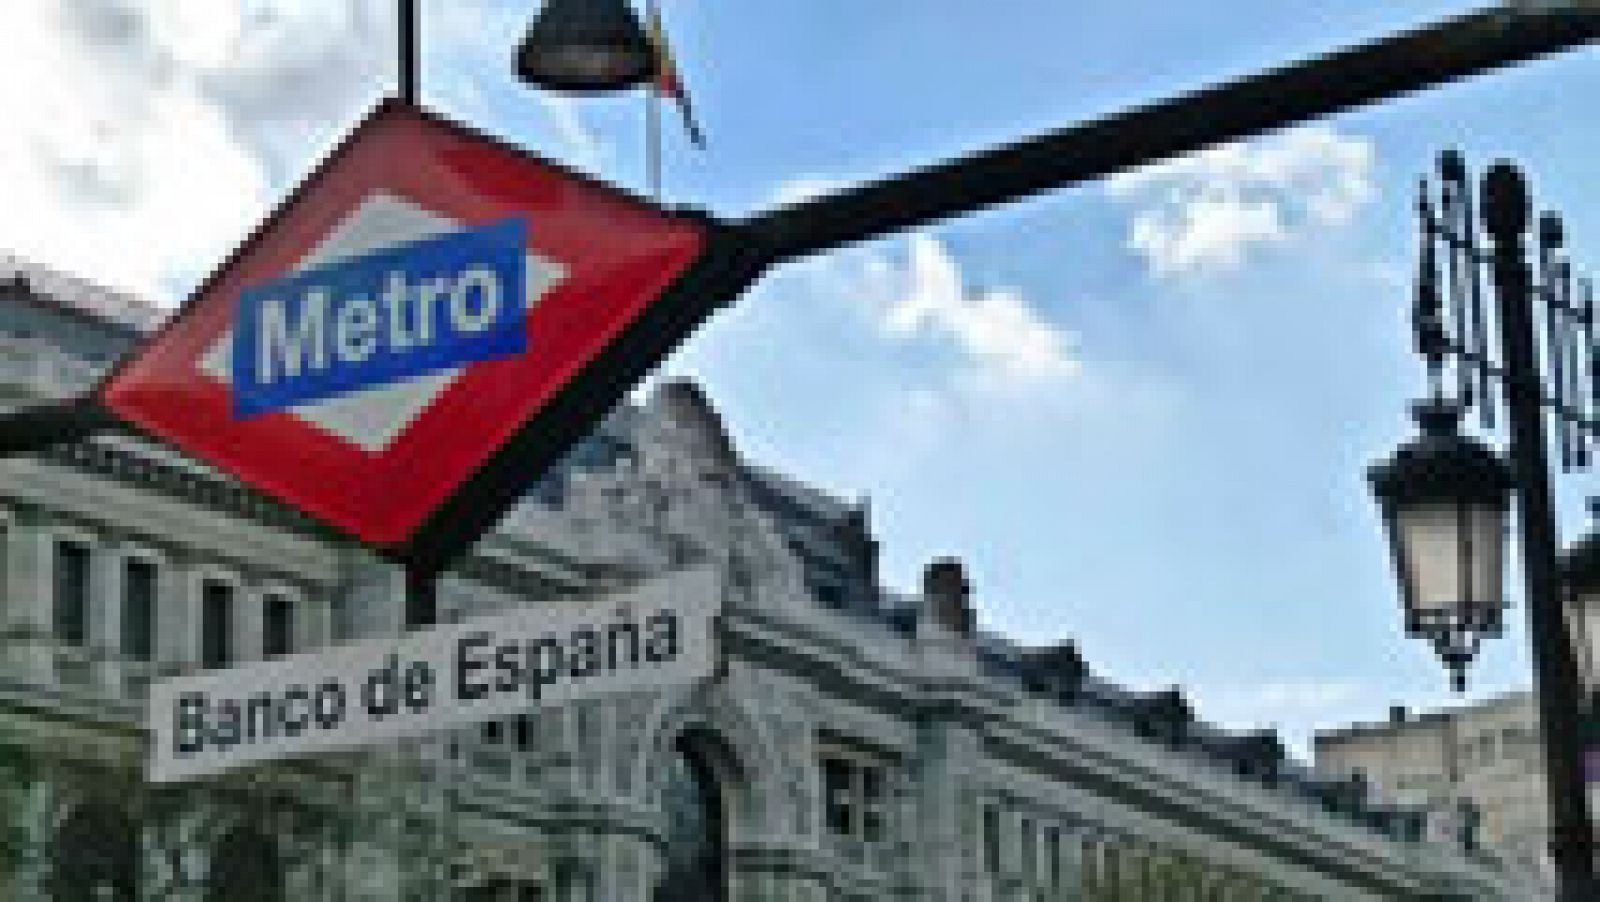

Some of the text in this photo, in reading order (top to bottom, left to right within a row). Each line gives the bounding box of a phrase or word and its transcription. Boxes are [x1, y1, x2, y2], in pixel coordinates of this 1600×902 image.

[257, 268, 499, 384] Metro
[175, 609, 677, 752] Banco de España
